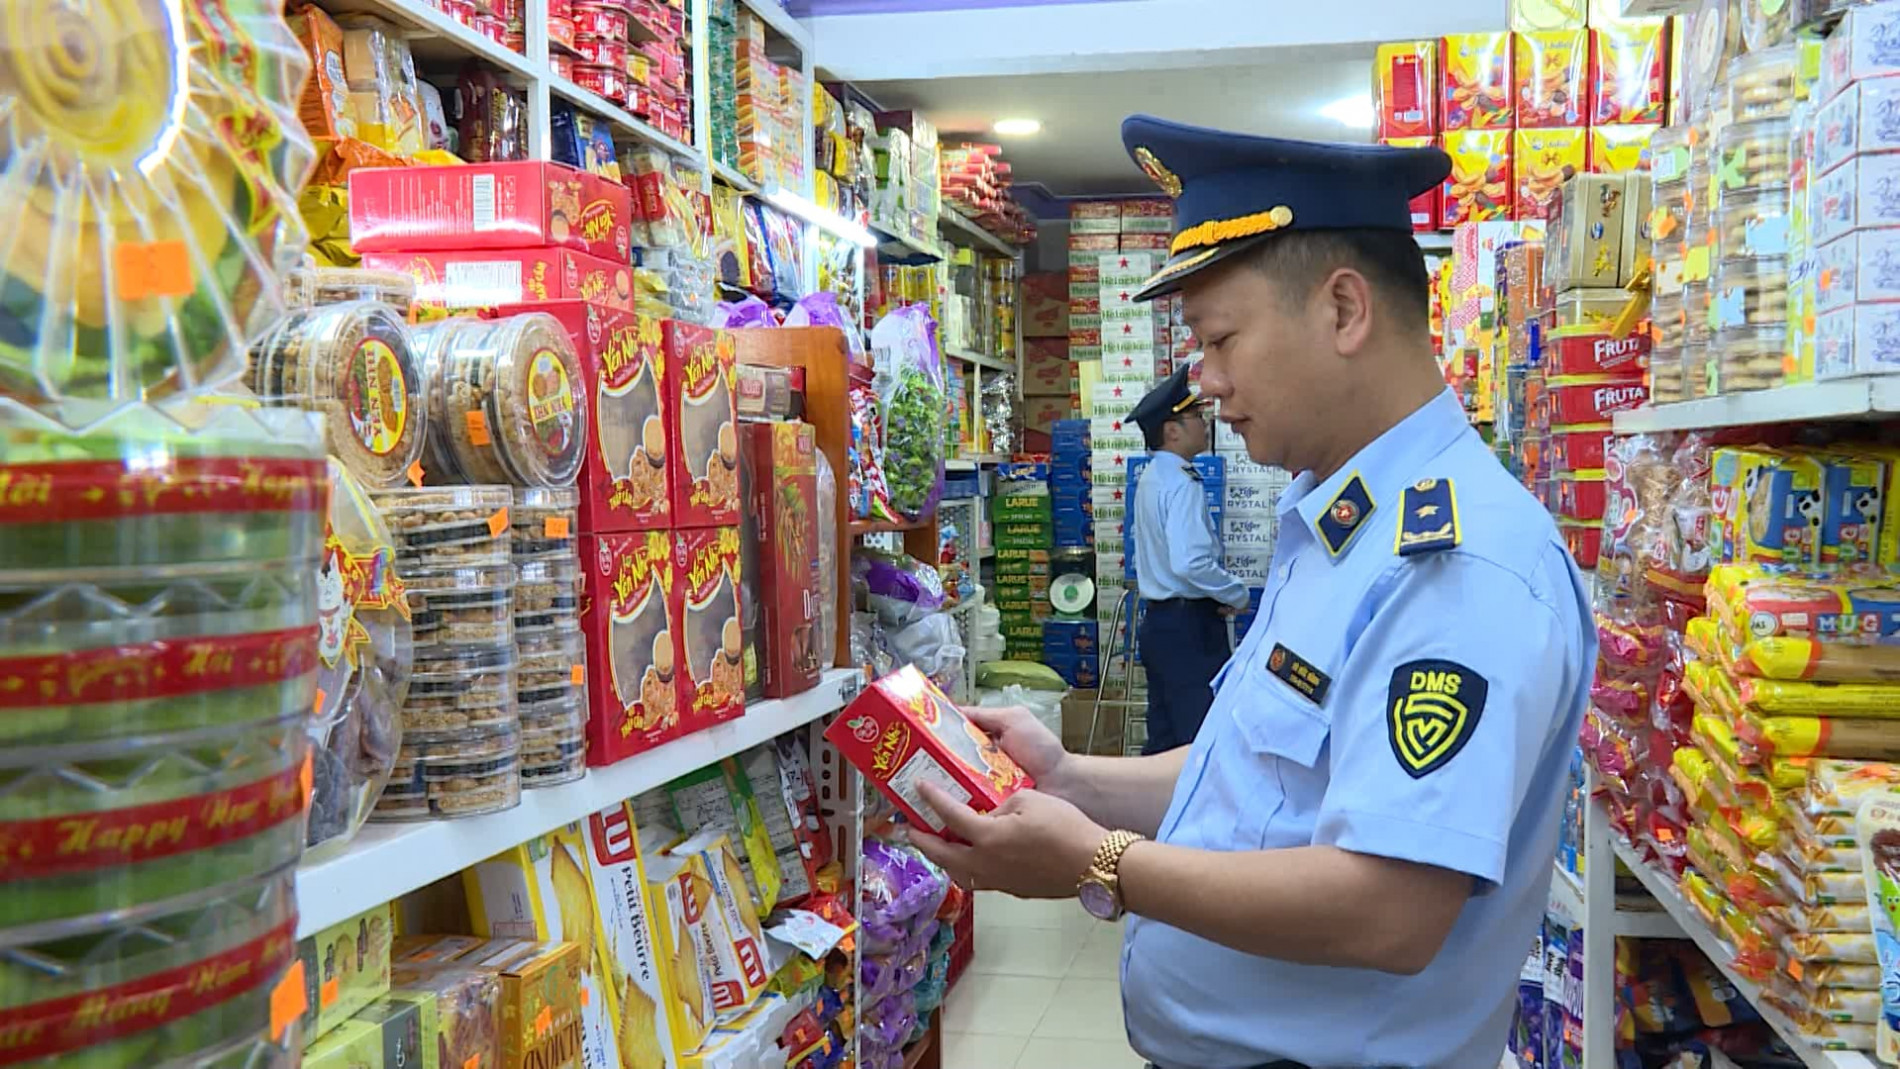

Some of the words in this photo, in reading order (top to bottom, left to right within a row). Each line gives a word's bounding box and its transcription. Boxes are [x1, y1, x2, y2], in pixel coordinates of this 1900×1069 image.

[1102, 309, 1151, 319] Heineken
[1103, 343, 1153, 353] Heineken
[1594, 387, 1644, 411] FRUTA
[1094, 439, 1143, 449] Heineken
[1005, 498, 1038, 507] LARUE
[1240, 521, 1260, 532] Tiger
[997, 550, 1028, 559] LARUE
[996, 576, 1027, 585] LARUE
[1819, 614, 1878, 632] MUG
[1410, 671, 1462, 694] DMS
[630, 913, 650, 981] Beurre
